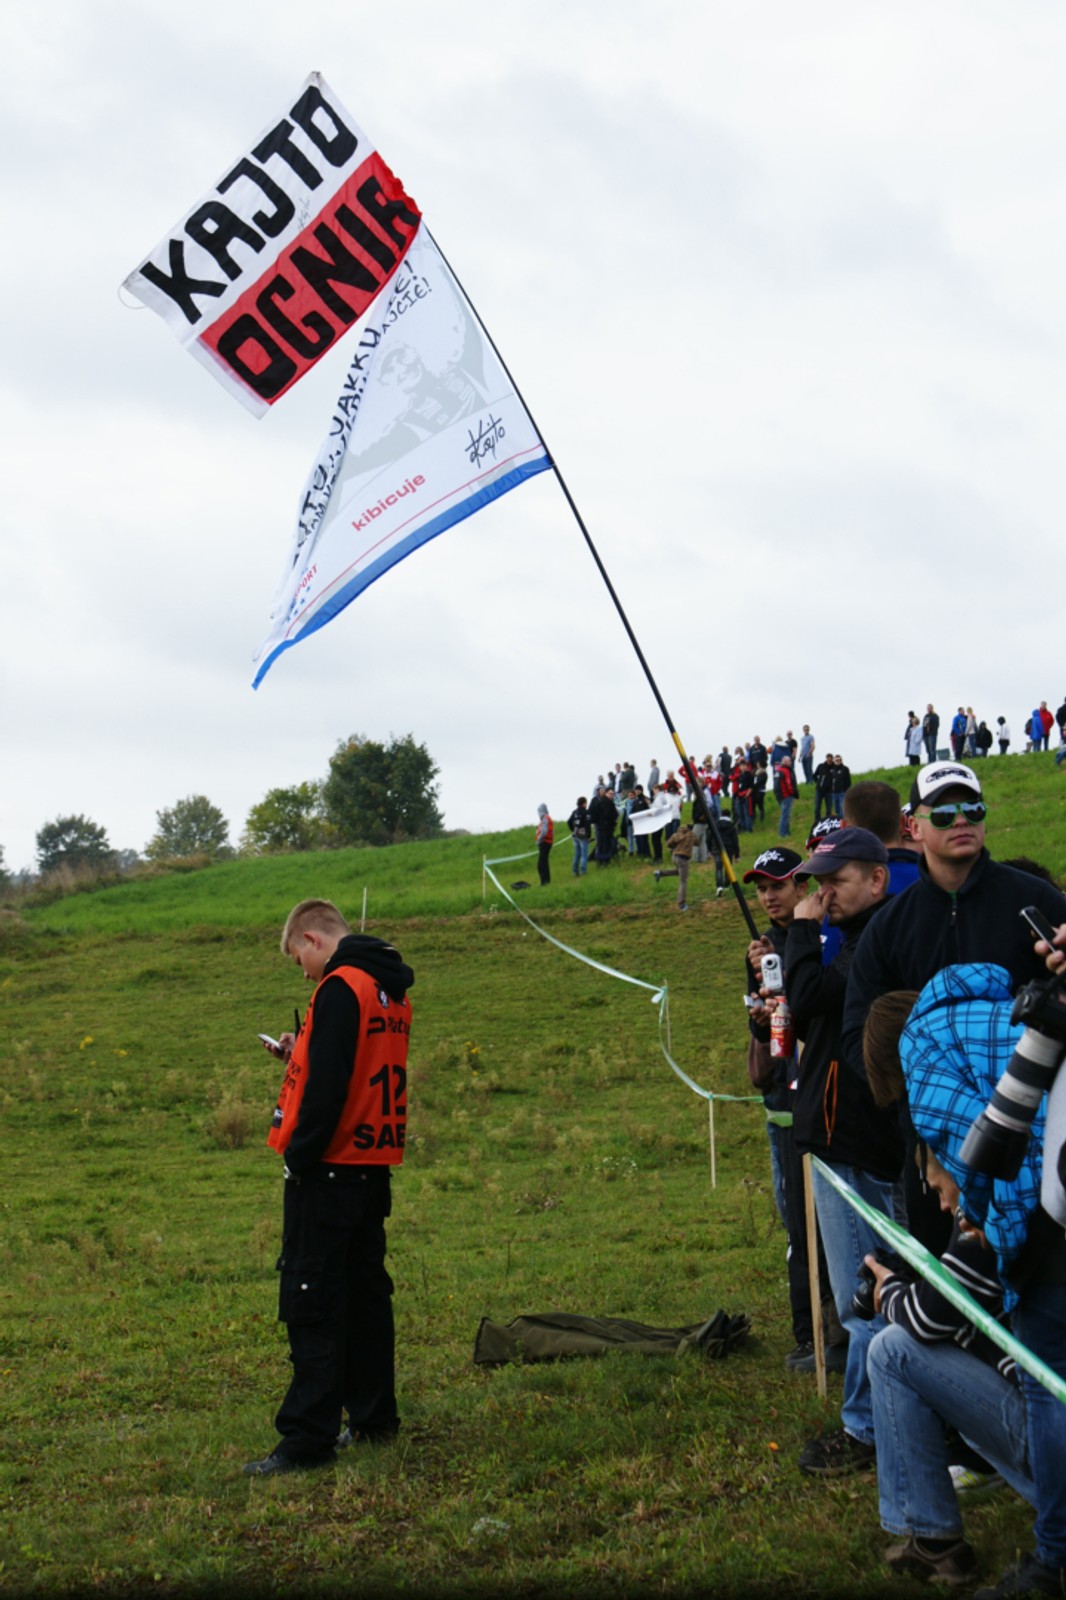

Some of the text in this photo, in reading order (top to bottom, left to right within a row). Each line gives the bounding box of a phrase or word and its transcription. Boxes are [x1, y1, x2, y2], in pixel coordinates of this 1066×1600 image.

[139, 85, 358, 326] KAJTO
[351, 473, 426, 532] kibicuje
[369, 1064, 406, 1117] 12
